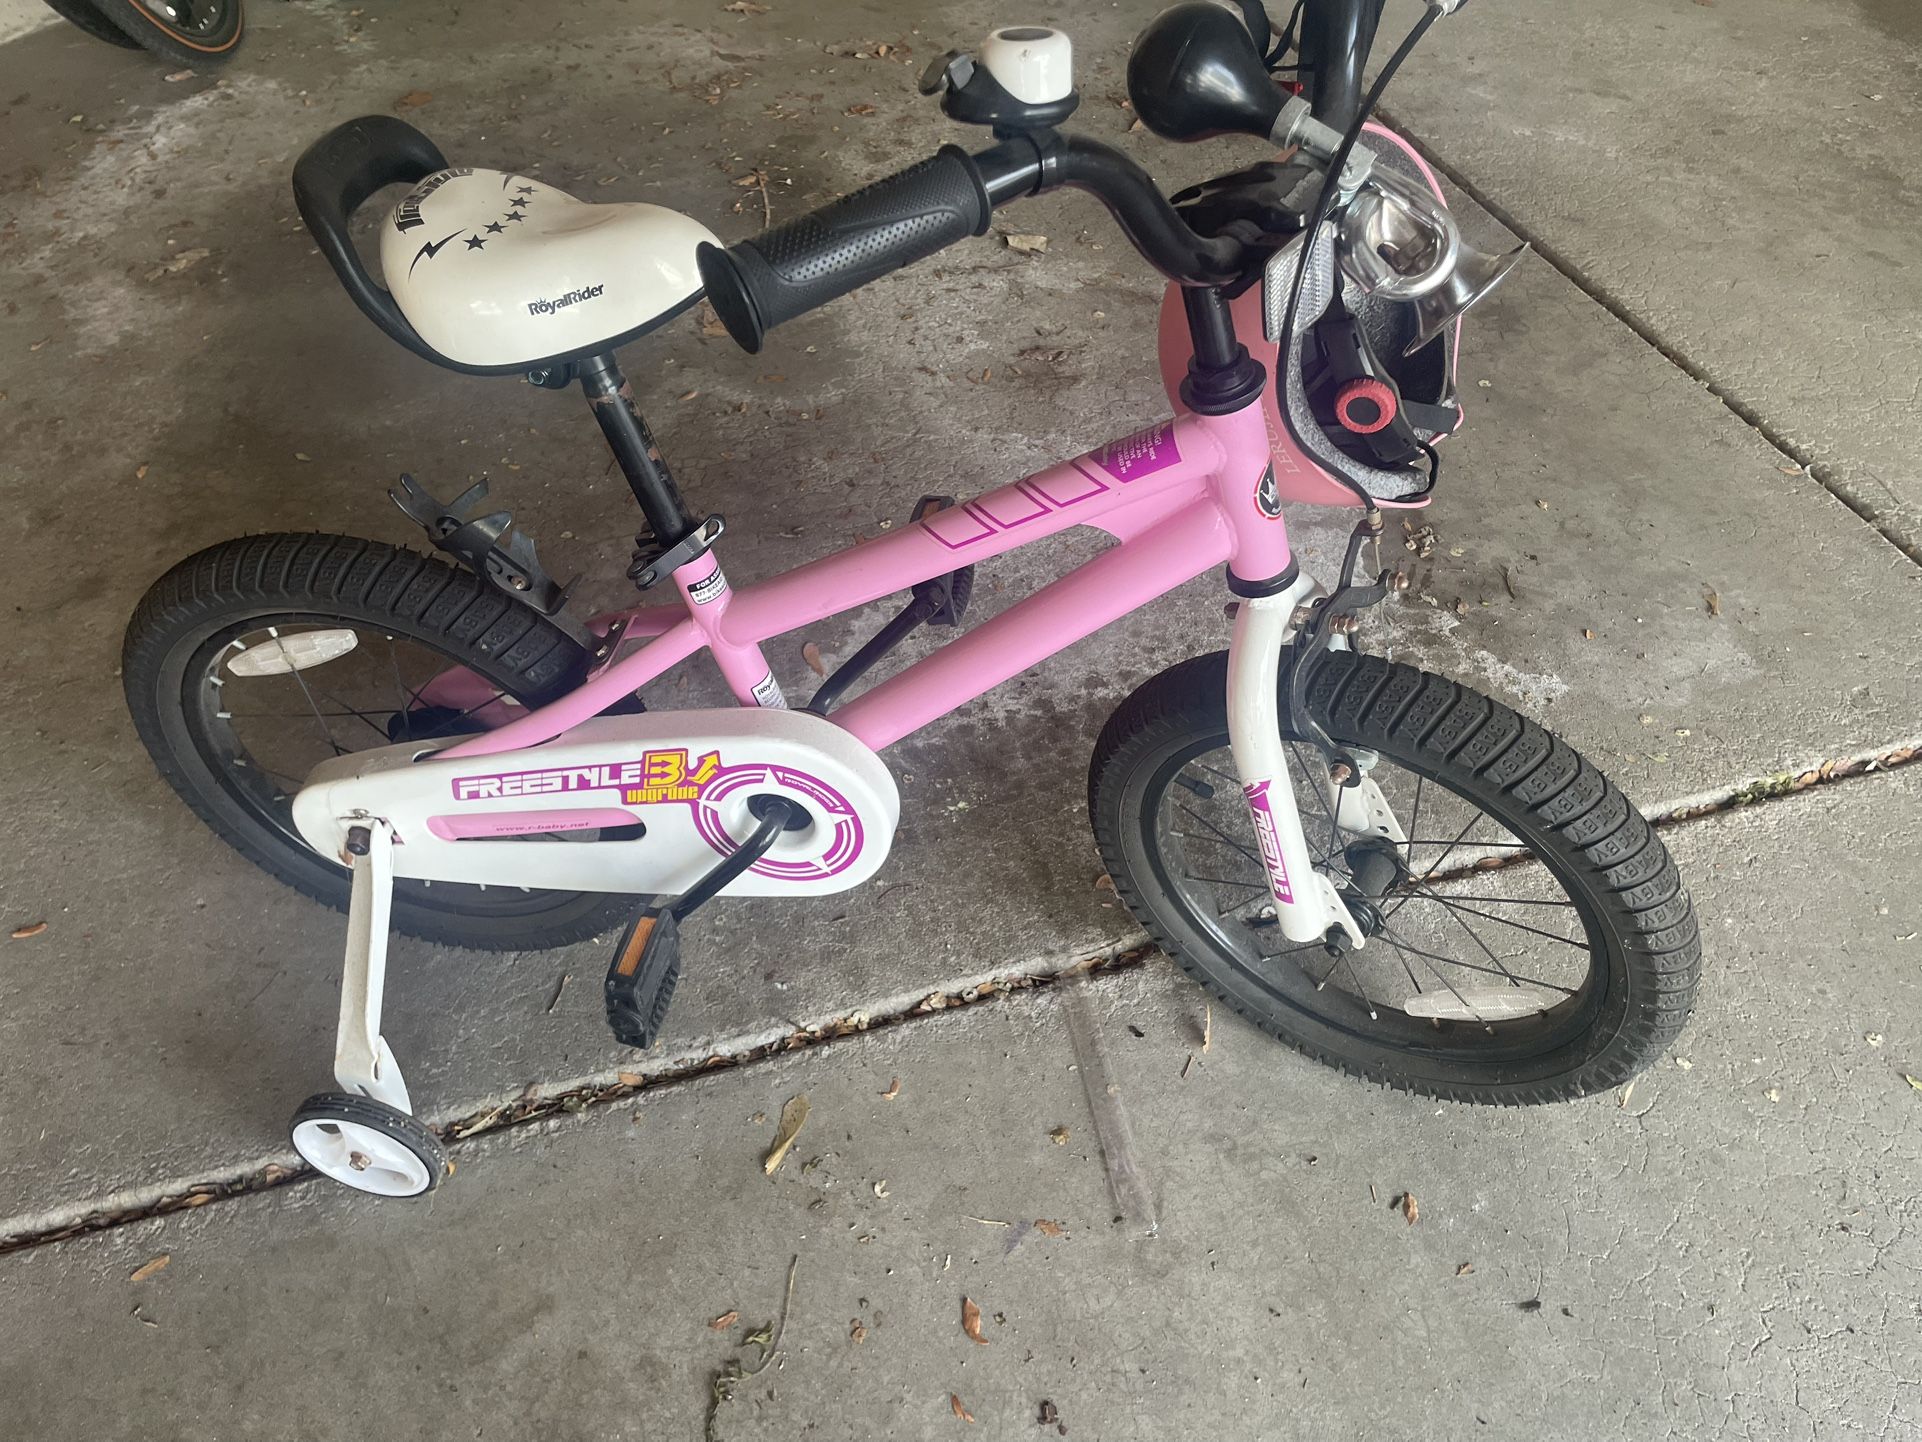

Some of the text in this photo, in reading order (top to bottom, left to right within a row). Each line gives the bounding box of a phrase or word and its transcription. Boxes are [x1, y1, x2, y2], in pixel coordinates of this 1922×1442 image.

[527, 283, 604, 316] RoyalRider
[459, 763, 642, 800] FREESTYLE
[626, 785, 698, 804] upgrade
